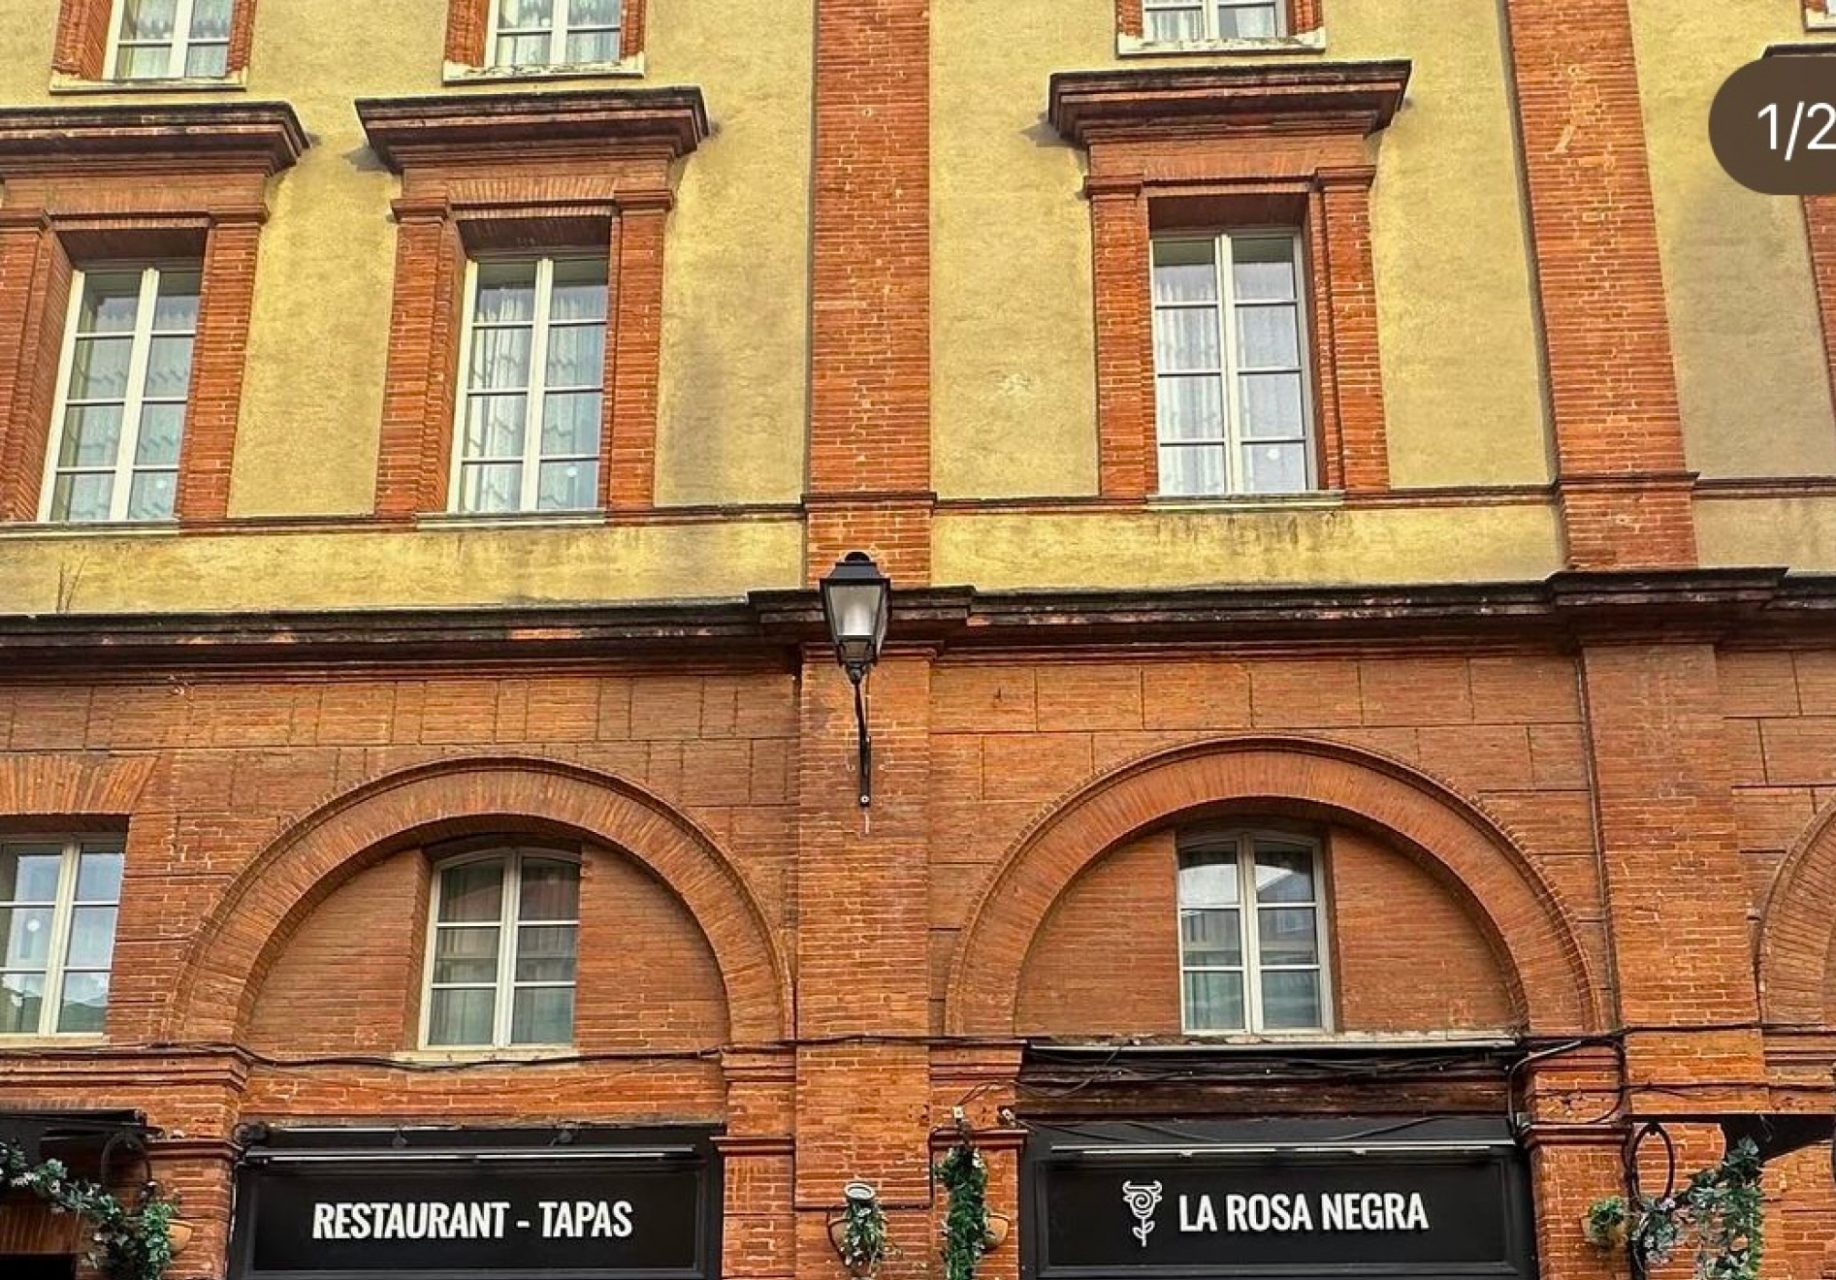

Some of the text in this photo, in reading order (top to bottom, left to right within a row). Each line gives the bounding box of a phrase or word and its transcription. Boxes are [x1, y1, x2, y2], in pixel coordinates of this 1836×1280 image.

[312, 1200, 634, 1239] RESTAURANT - TAPAS
[1178, 1192, 1430, 1232] LA ROSA NEGRA
